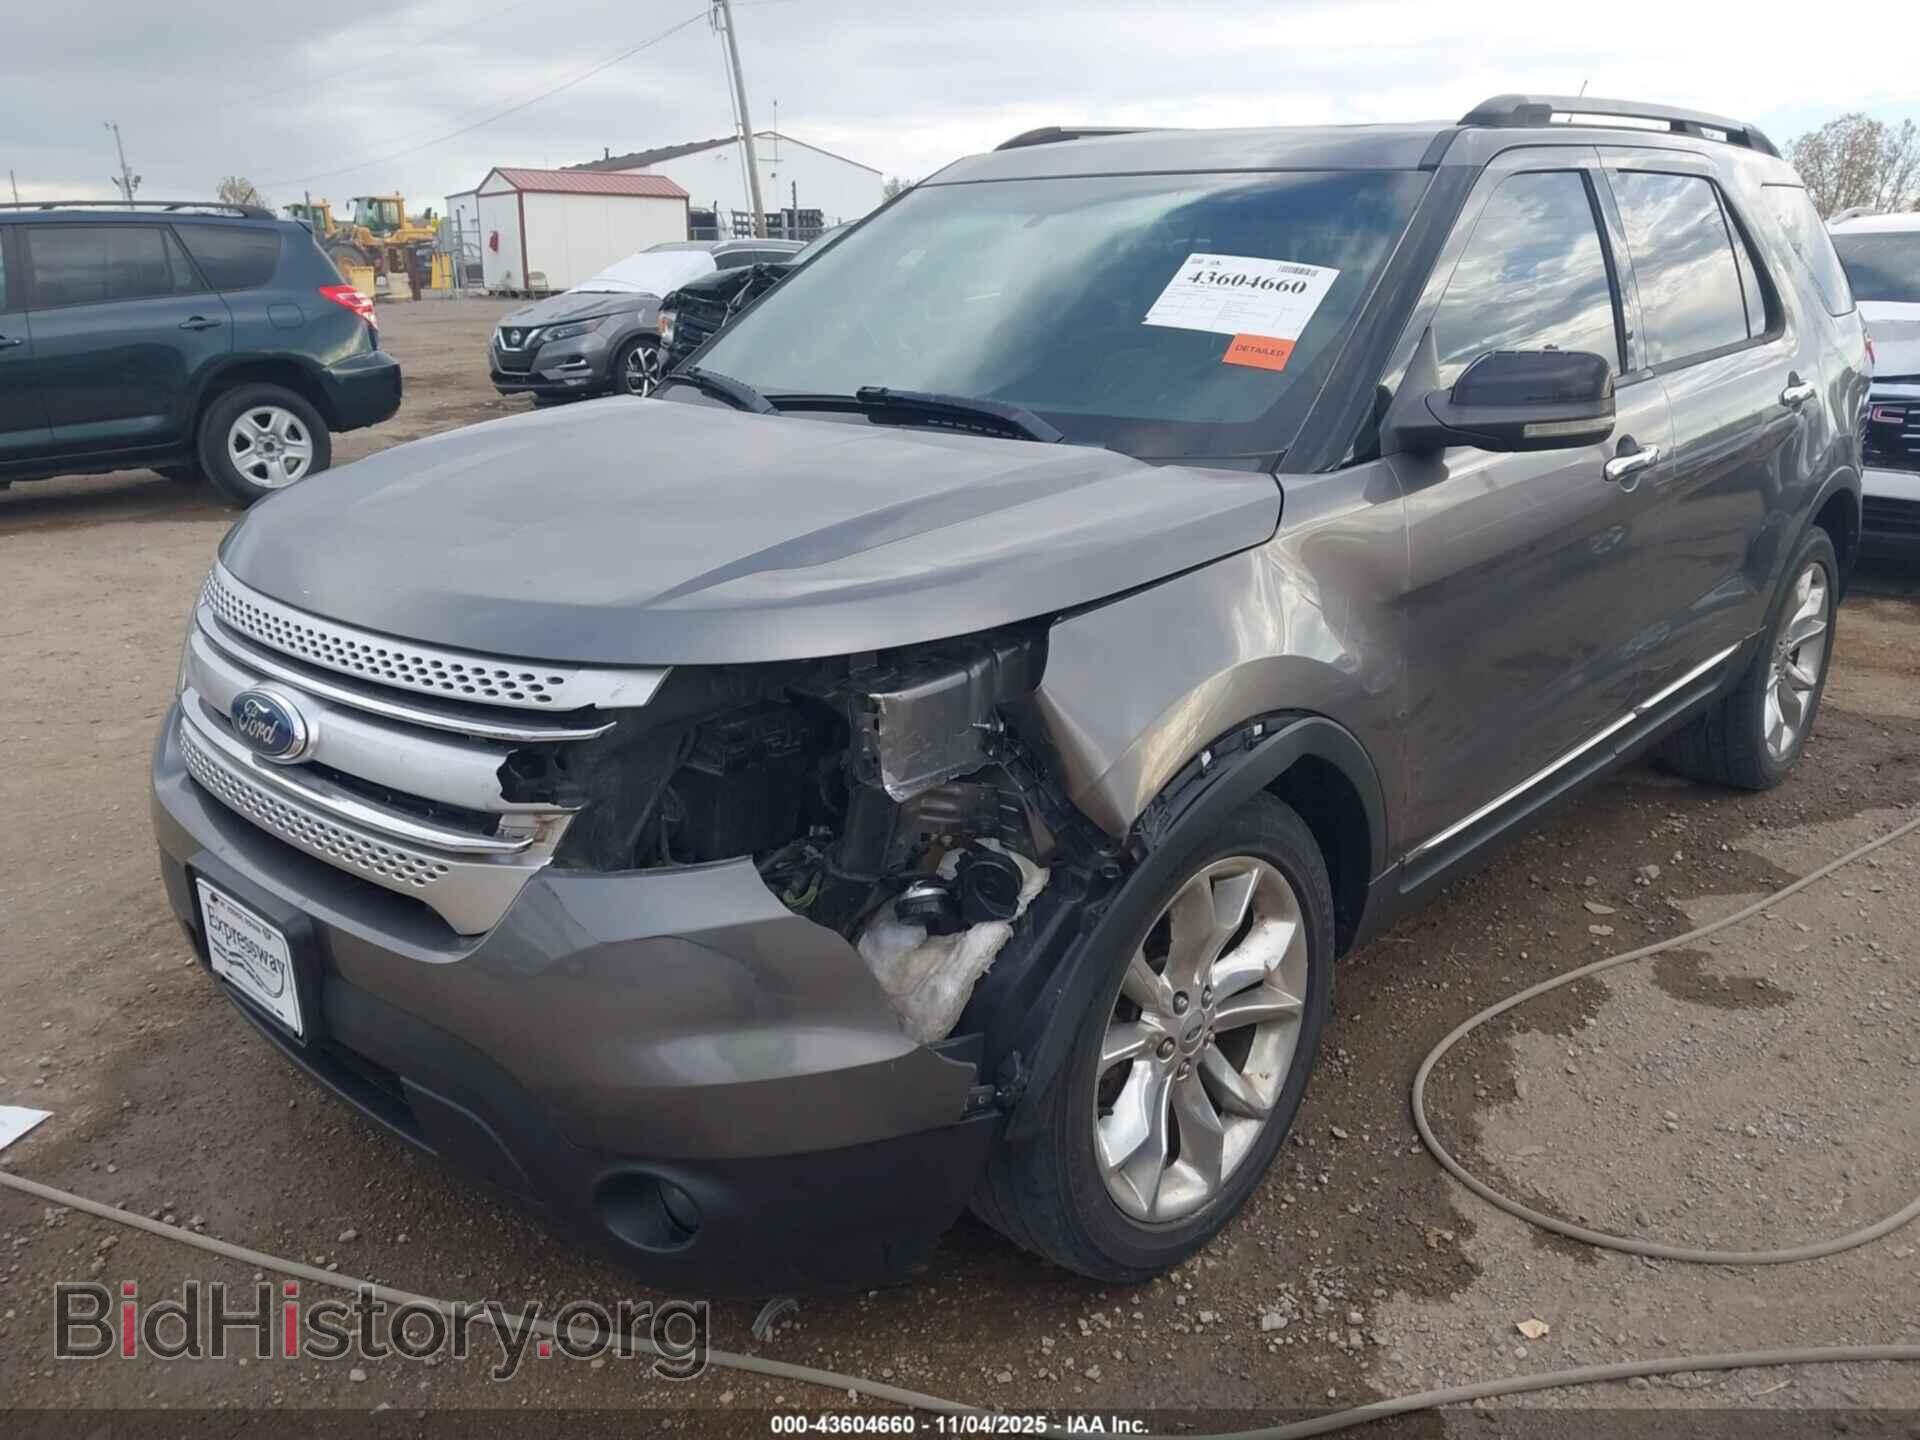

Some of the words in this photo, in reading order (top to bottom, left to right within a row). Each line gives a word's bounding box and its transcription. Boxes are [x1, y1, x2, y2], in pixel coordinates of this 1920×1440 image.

[1187, 270, 1309, 295] 43604660
[1234, 343, 1285, 358] DETAILED
[239, 699, 280, 745] Ford
[206, 902, 286, 977] Expressway
